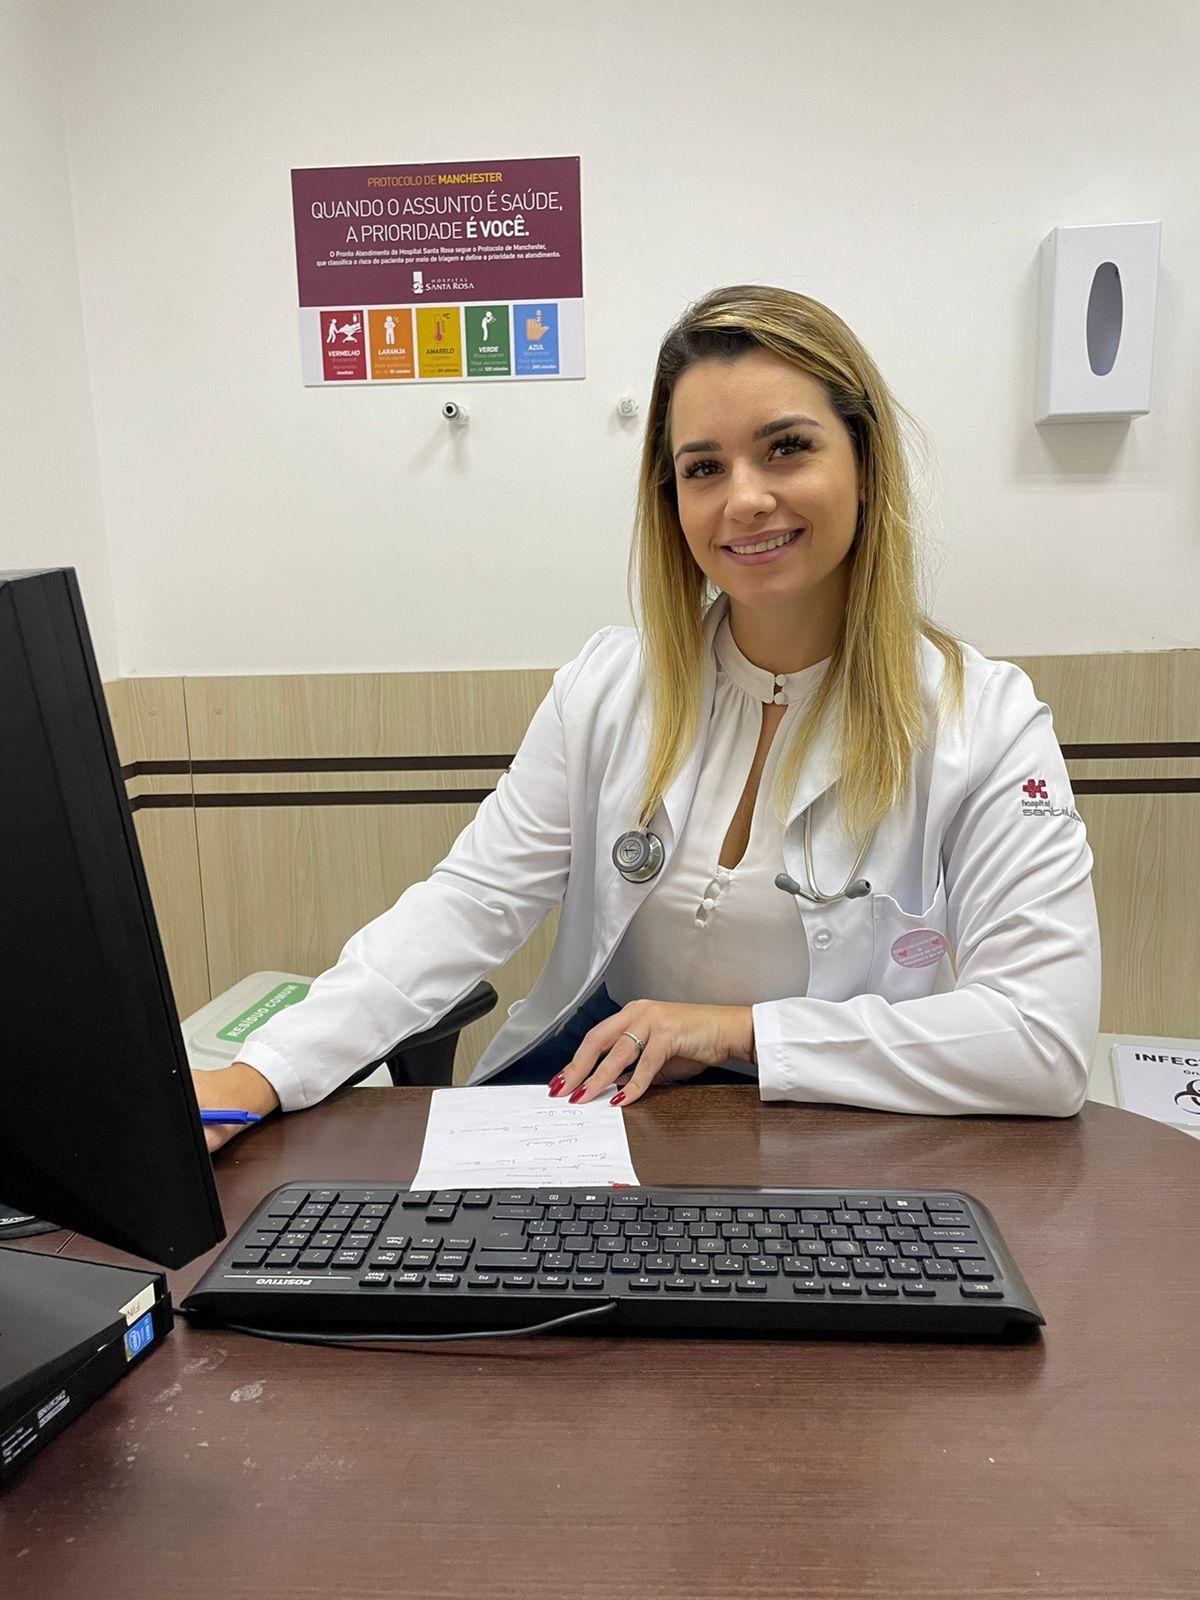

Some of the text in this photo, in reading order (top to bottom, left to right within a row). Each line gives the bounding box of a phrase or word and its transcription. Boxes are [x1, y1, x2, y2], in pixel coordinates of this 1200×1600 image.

[367, 172, 503, 188] PROTOCOLO DE MANCHESTER
[311, 188, 563, 219] QUANDO O ASSUNTO É SAÚDE,
[346, 214, 530, 243] A PRIORIDADE É VOCÊ.
[355, 249, 390, 257] Atendimento
[399, 248, 422, 256] Hospital
[440, 246, 454, 254] Rosa
[513, 243, 547, 251] Manchester,
[438, 255, 459, 263] triagem
[488, 253, 516, 261] prioridade
[525, 251, 561, 259] atendimento.
[425, 282, 475, 291] SANTA ROSA
[328, 349, 361, 357] VERMELHO
[377, 348, 406, 356] LARANJA
[425, 347, 455, 355] AMARELO
[1021, 800, 1051, 808] hospital
[227, 984, 298, 1037] RESÍDUO COMUM
[1134, 1053, 1200, 1067] INFEC
[255, 1278, 312, 1286] POSITIVO
